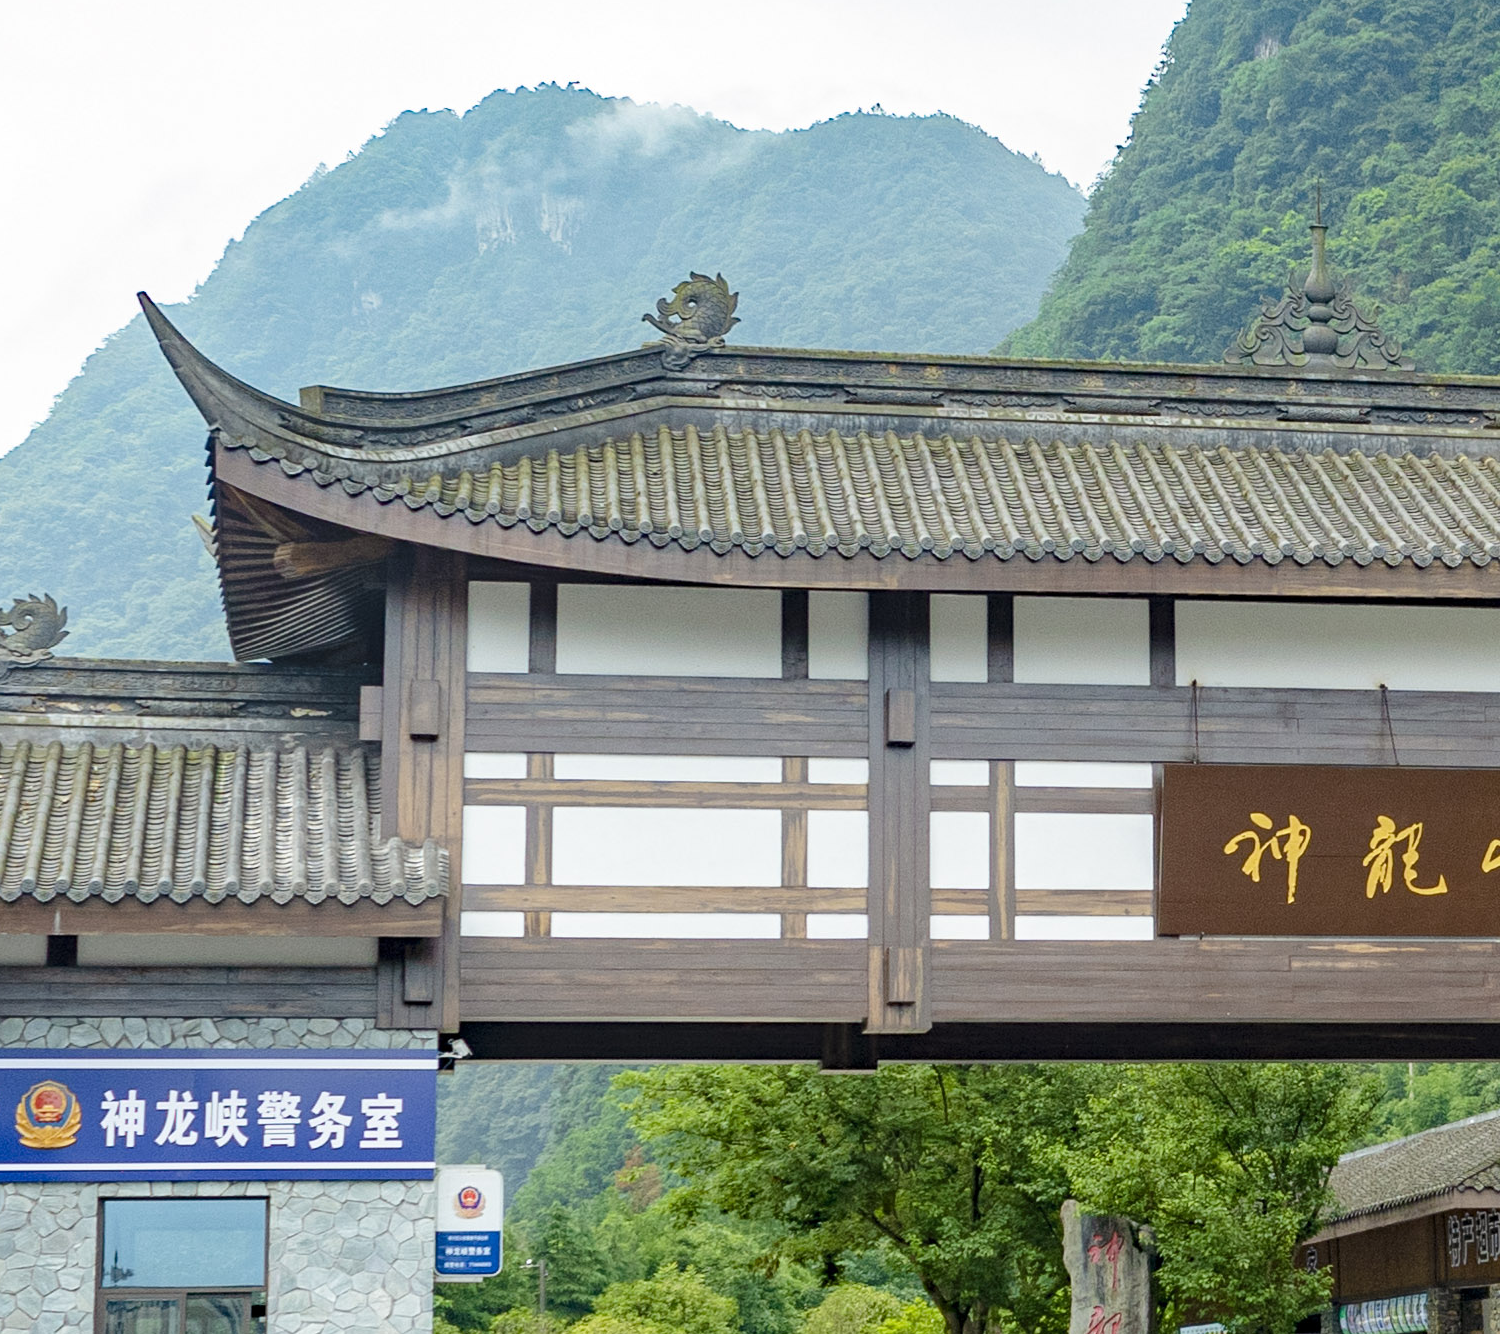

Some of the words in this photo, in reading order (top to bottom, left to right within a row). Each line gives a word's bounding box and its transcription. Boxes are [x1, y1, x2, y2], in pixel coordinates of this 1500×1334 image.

[100, 1089, 403, 1150] 神龙峡警务室
